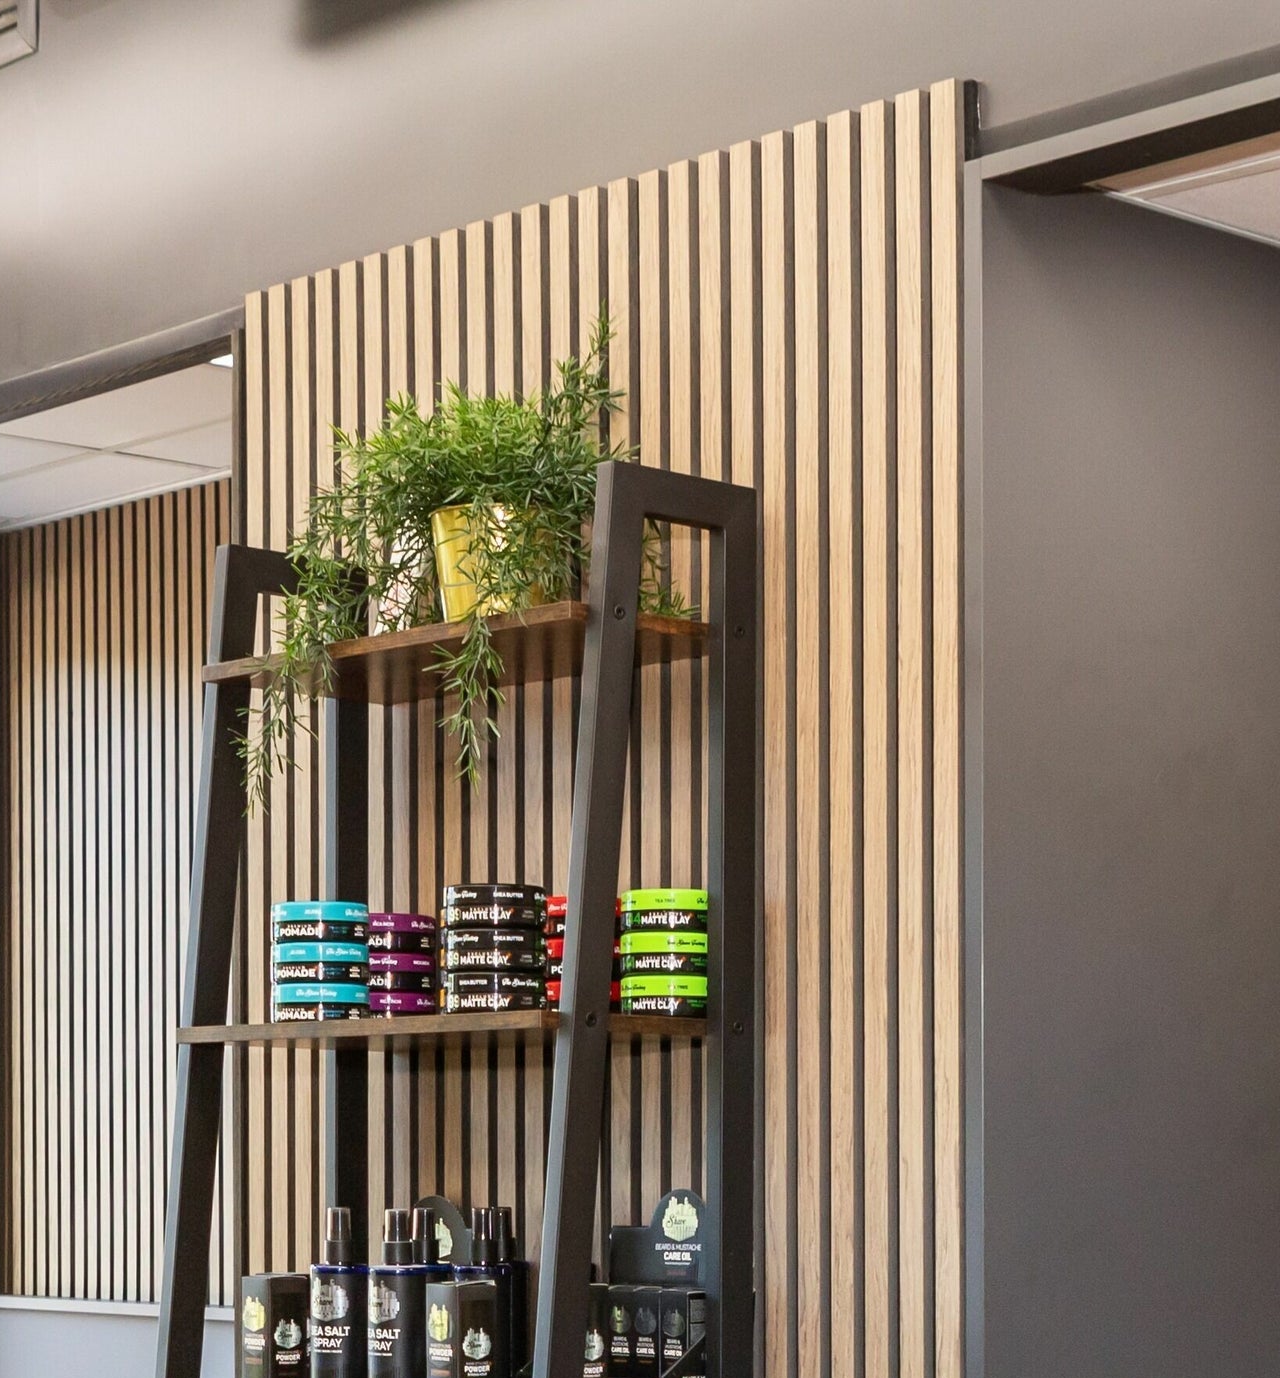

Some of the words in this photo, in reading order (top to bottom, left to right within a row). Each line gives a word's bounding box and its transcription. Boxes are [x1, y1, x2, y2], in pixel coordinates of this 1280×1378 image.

[462, 909, 488, 920] MATTE
[489, 909, 512, 920] CLAY
[641, 914, 667, 925] MATTE
[668, 914, 691, 925] CLAY
[460, 954, 486, 965] MATTE
[487, 954, 510, 965] CLAY
[635, 959, 661, 968] MATTE
[661, 959, 684, 969] CLAY
[277, 968, 316, 978] POMADE
[460, 997, 487, 1008] MATTE
[487, 997, 510, 1008] CLAY
[632, 1001, 657, 1010] MATTE
[657, 1000, 680, 1010] CLAY
[275, 1011, 315, 1020] POMADE
[663, 1251, 681, 1261] CARE
[681, 1251, 692, 1261] OIL
[324, 1326, 351, 1337] SALT
[376, 1328, 401, 1339] SALT
[313, 1337, 342, 1348] SPRAY
[464, 1365, 490, 1374] POWDER
[583, 1366, 603, 1374] OWDER
